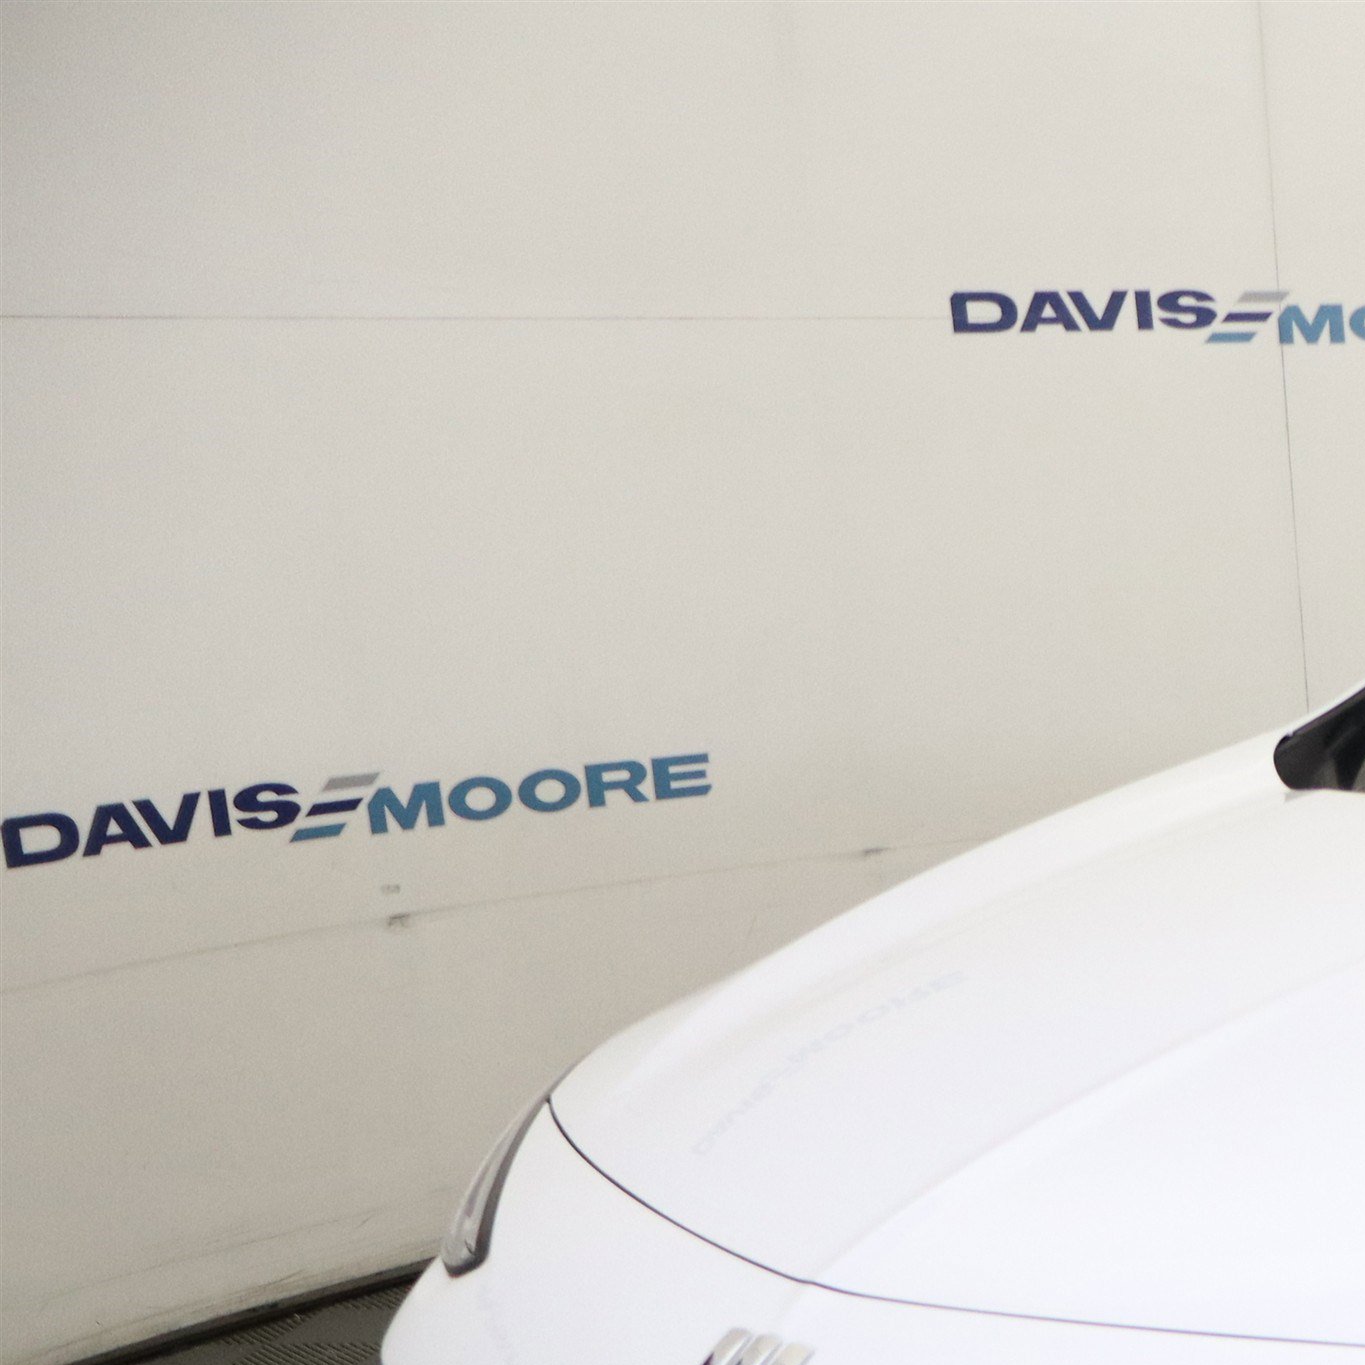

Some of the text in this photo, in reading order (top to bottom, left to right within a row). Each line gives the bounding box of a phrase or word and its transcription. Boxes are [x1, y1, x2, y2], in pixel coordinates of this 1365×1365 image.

[949, 289, 1217, 334] DAVIS
[0, 752, 712, 869] DAVIS MOORE
